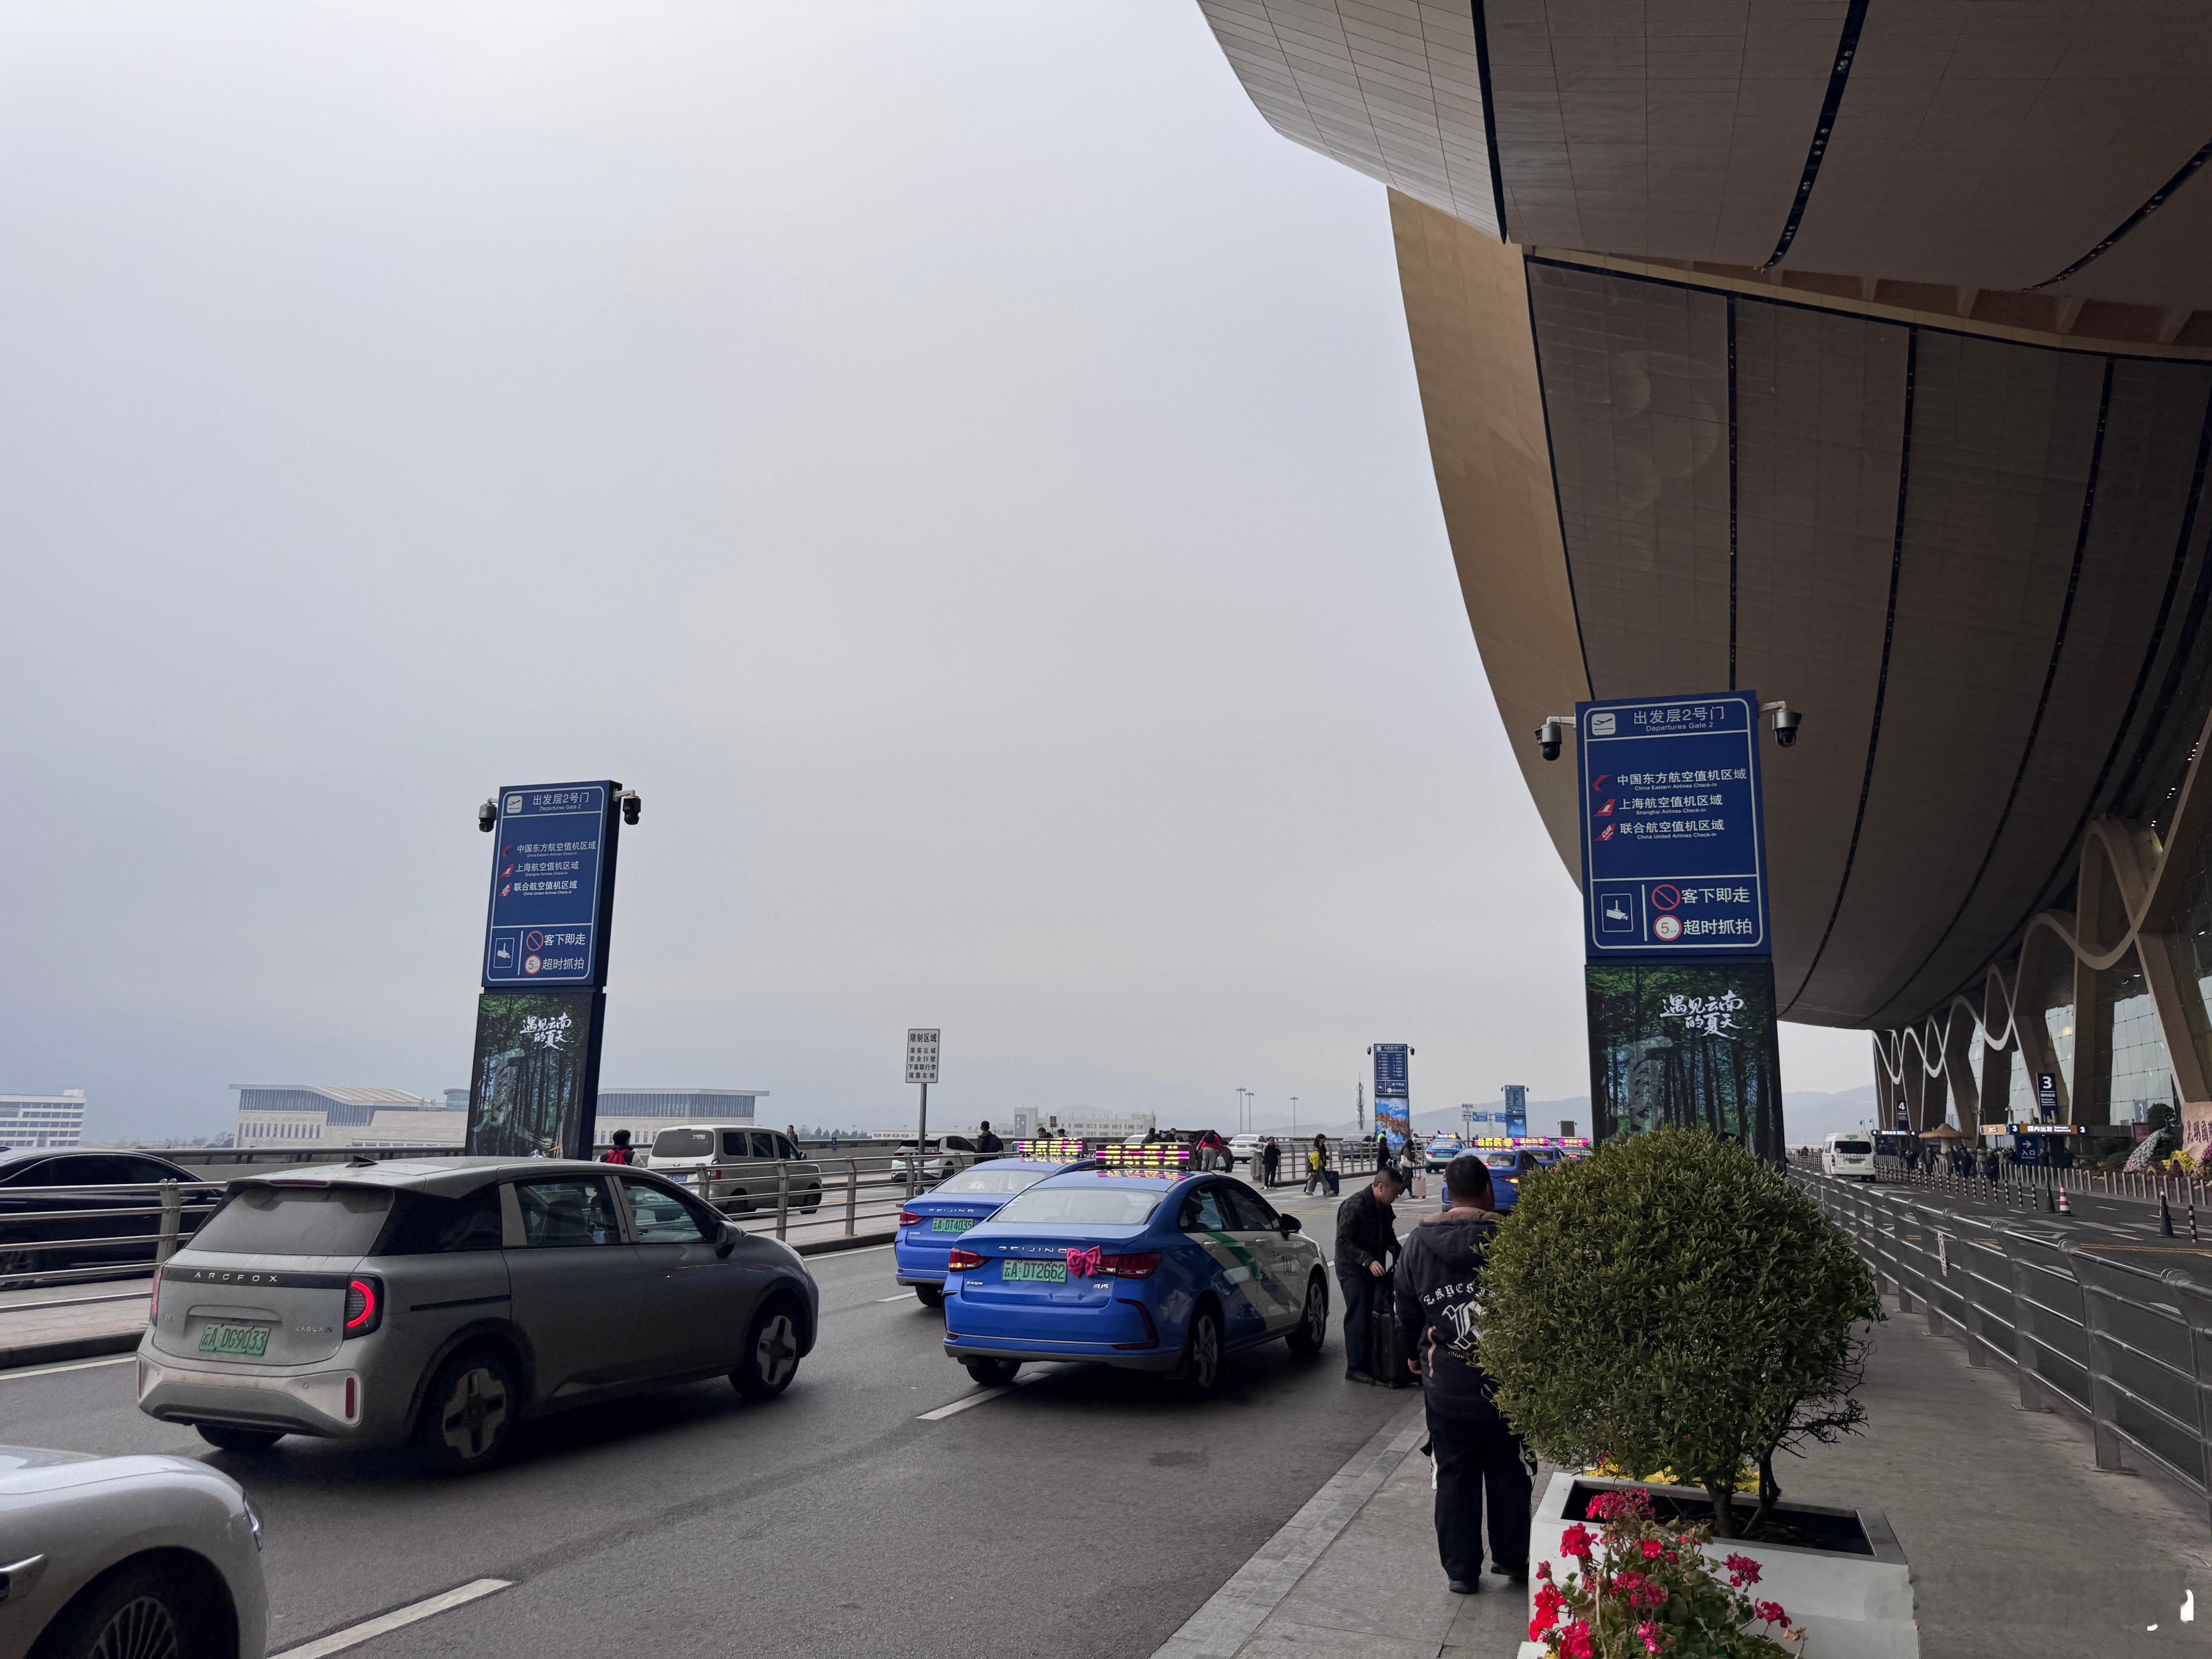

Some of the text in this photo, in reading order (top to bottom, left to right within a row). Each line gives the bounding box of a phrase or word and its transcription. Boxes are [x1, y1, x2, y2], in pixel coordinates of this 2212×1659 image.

[1634, 706, 1724, 725] 出发层2号门
[1646, 723, 1686, 732] Departures
[1617, 768, 1747, 786] 中国东方航空值机区域
[533, 792, 589, 805] 出发层2号门
[1618, 794, 1723, 810] 上海航空值机区域
[1602, 825, 1612, 838] CUA
[1620, 819, 1724, 835] 联合航空值机区域
[517, 841, 596, 853] 中国东方航空值机区域
[515, 861, 579, 872] 上海航空值机区域
[514, 880, 577, 891] 联合航空值机区域
[1682, 887, 1750, 903] 客下即走
[1661, 922, 1669, 934] 5
[1683, 919, 1752, 935] 超时抓拍
[544, 933, 586, 946] 客下即走
[529, 960, 534, 969] 5
[542, 957, 584, 970] 超时抓拍
[1660, 989, 1744, 1018] 遇见云南
[520, 1012, 572, 1034] 遇见云南
[1685, 1012, 1743, 1040] 的夏天
[534, 1030, 569, 1051] 的夏天
[910, 1033, 936, 1042] 限制区域
[2042, 1076, 2052, 1089] 3
[1898, 1102, 1905, 1110] 4
[195, 1271, 278, 1283] ARCFOX
